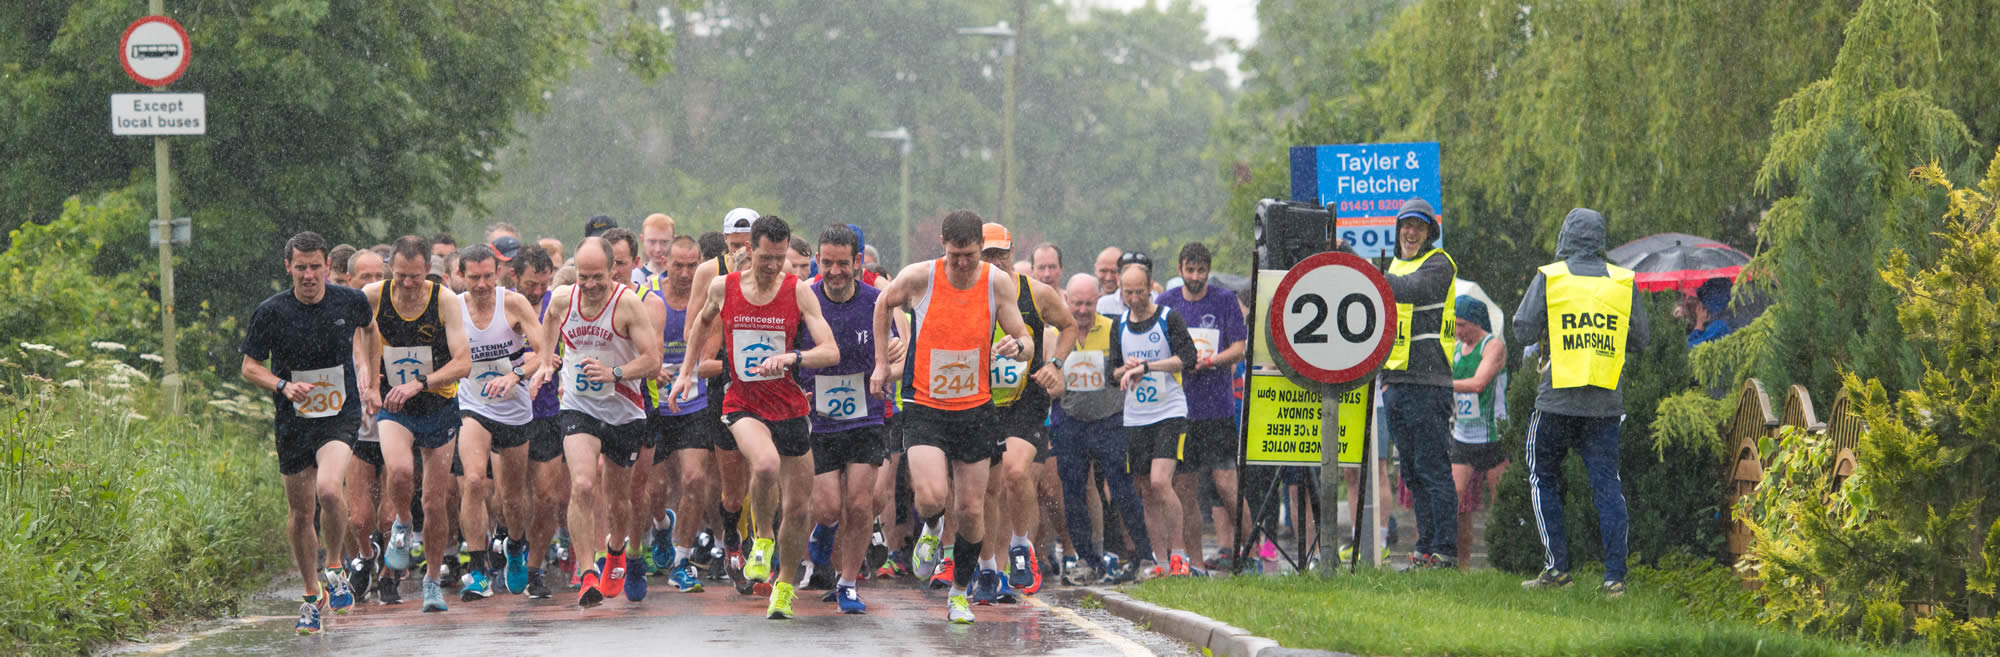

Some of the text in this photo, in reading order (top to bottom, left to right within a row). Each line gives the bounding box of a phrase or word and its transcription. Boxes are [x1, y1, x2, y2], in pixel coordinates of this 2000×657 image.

[133, 99, 184, 113] Except
[117, 115, 200, 128] local buses
[1336, 150, 1420, 175] Tayler &
[1337, 174, 1419, 194] Fletcher
[1340, 199, 1405, 211] 01451 8209
[1342, 229, 1395, 247] SOL
[733, 314, 785, 325] cirencester
[1291, 293, 1377, 344] 20
[1561, 312, 1618, 331] RACE
[567, 325, 614, 342] GLOUCESTER
[471, 340, 514, 354] ELTENHAM
[1562, 333, 1616, 352] MARSHAL
[933, 372, 976, 395] 244
[1066, 371, 1103, 388] 210
[299, 389, 343, 415] 230
[1135, 386, 1159, 404] 62
[1257, 387, 1276, 401] 6pm
[1338, 392, 1361, 404] STAR
[827, 397, 857, 418] 26
[1277, 407, 1314, 420] SUNDAY
[1266, 423, 1291, 436] HERE
[1262, 440, 1297, 453] NOTICE
